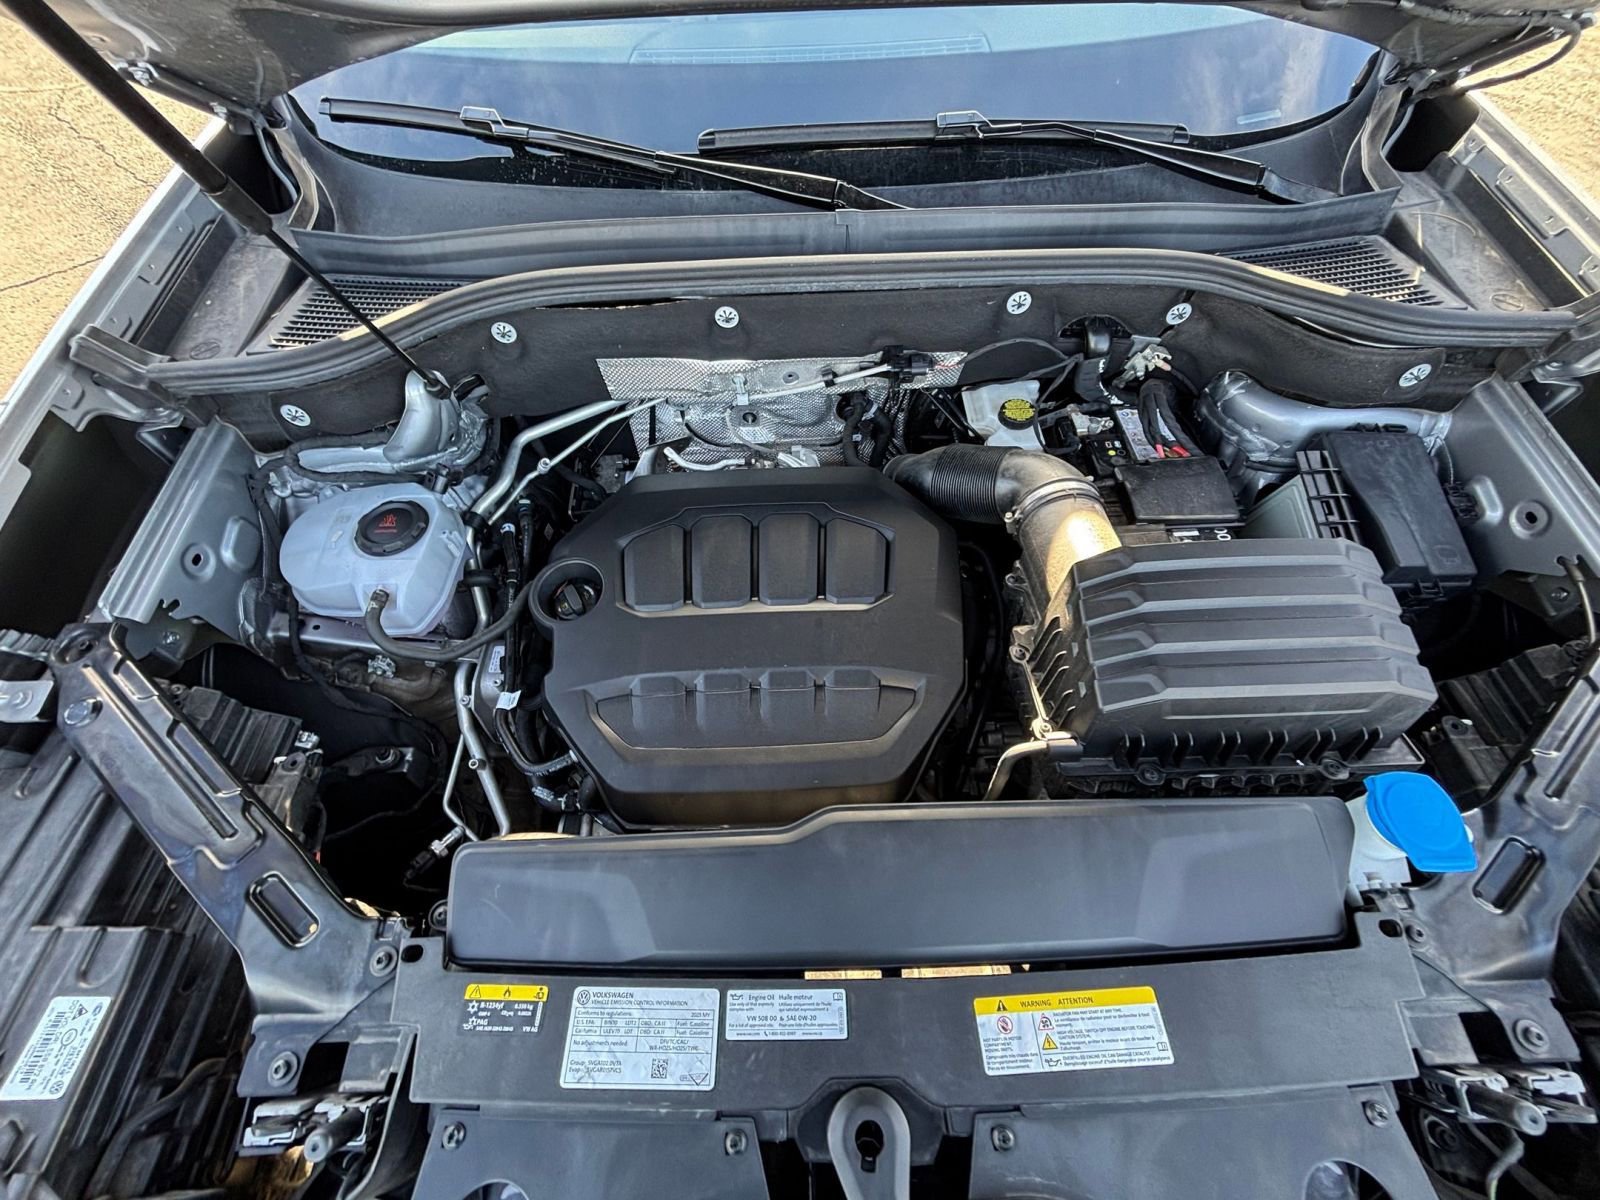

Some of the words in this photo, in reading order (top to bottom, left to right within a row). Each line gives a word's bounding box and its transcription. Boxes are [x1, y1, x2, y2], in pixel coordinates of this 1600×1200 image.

[748, 994, 766, 1002] Engine
[1020, 999, 1051, 1008] WARNING
[1058, 996, 1094, 1005] ATTENTION
[480, 1001, 505, 1010] R-1234yf
[476, 1018, 489, 1026] PAG
